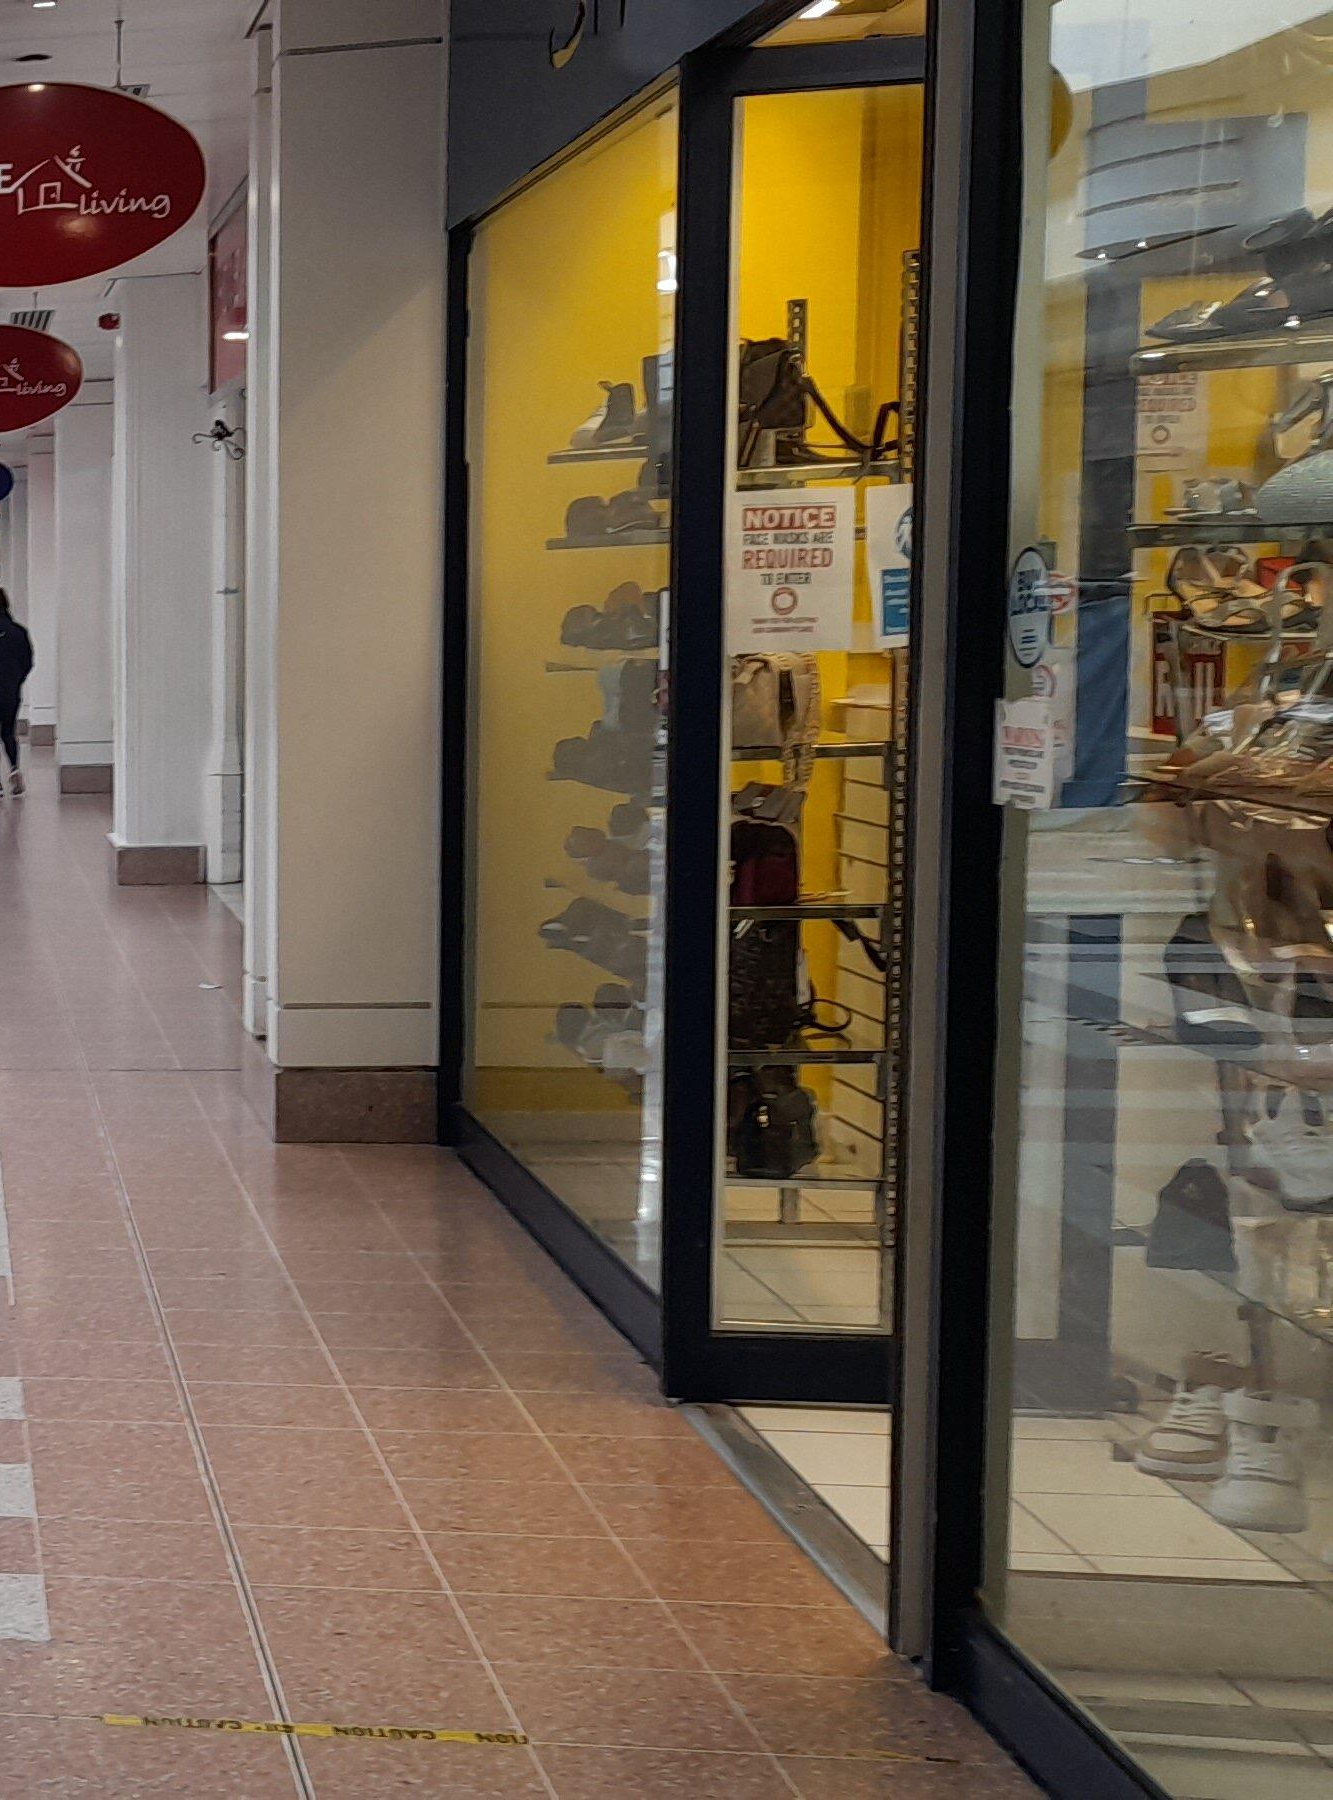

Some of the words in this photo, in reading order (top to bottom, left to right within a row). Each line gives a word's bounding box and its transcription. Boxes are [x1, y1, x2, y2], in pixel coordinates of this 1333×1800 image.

[79, 187, 171, 219] living
[16, 380, 67, 397] living
[744, 507, 835, 530] NOTICE
[741, 548, 834, 570] REQUIRED
[332, 1725, 436, 1742] CAUTION
